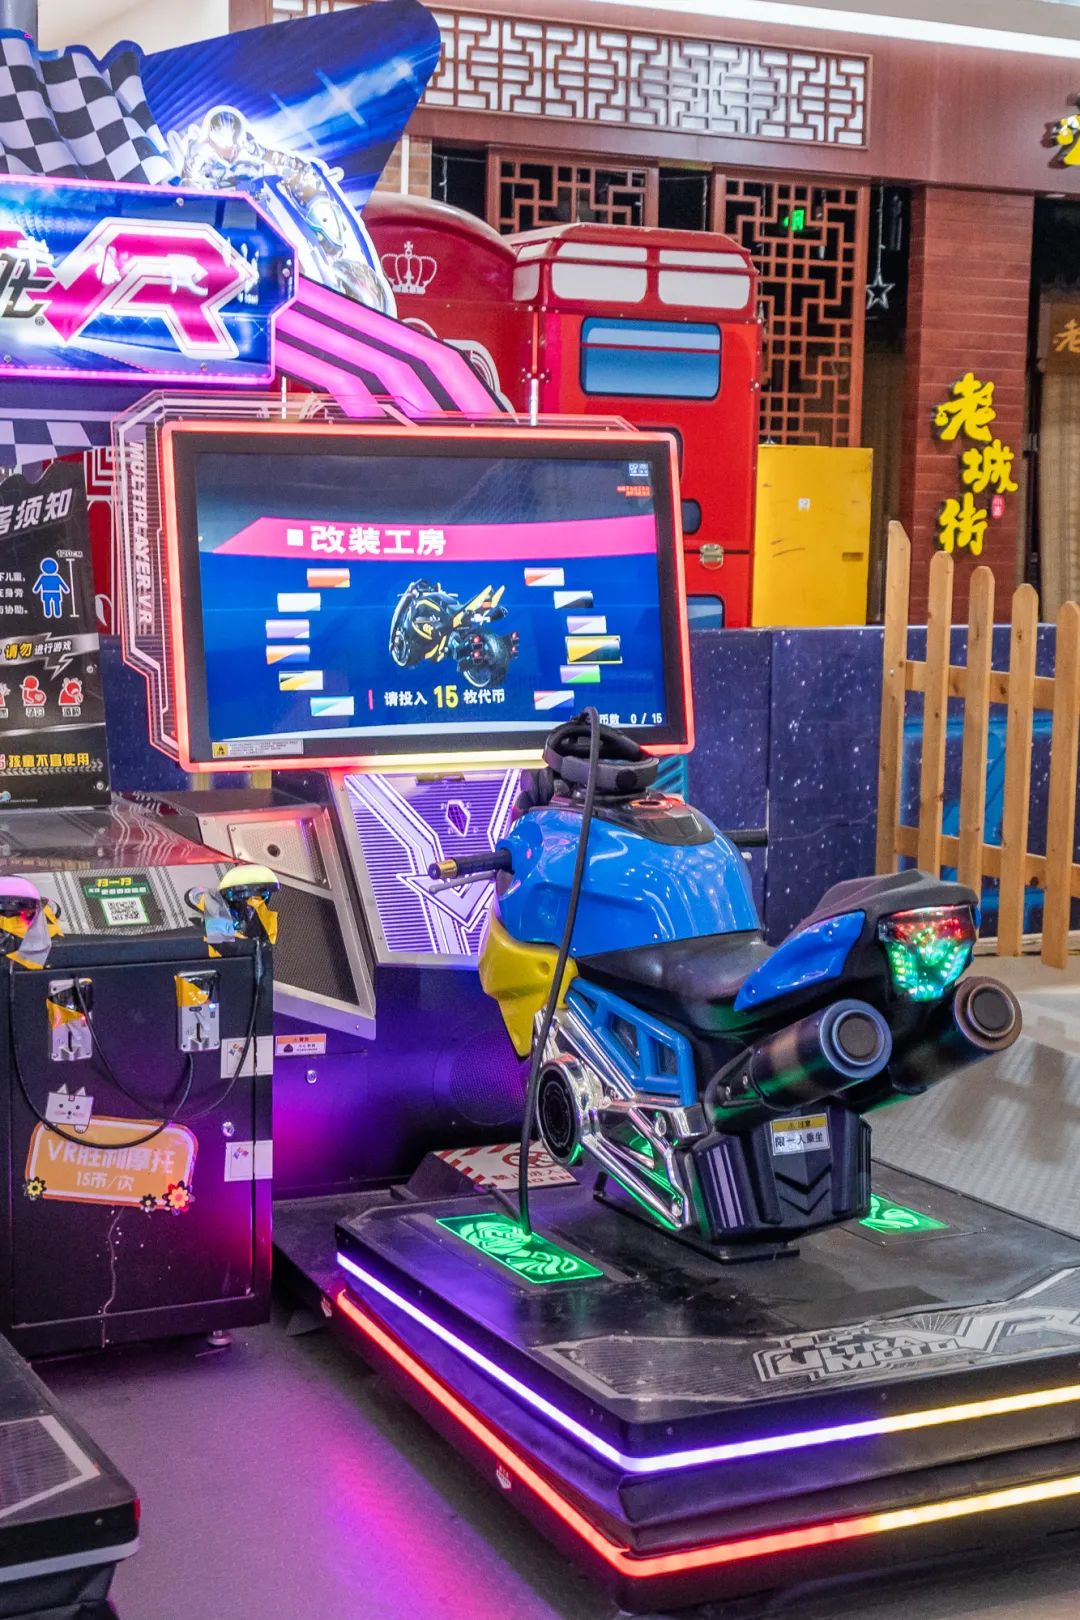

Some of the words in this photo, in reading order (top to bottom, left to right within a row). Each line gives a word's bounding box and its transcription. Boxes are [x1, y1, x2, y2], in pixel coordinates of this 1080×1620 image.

[934, 372, 1019, 556] 老城街
[129, 441, 152, 590] MULTIPLAYER
[310, 525, 447, 556] 改装工房
[137, 594, 153, 624] VR
[384, 691, 428, 707] 请投入
[433, 685, 459, 708] 15
[463, 688, 505, 704] 枚代币
[630, 713, 637, 724] 0
[652, 712, 663, 724] 15
[775, 1131, 823, 1148] 限一人乘坐
